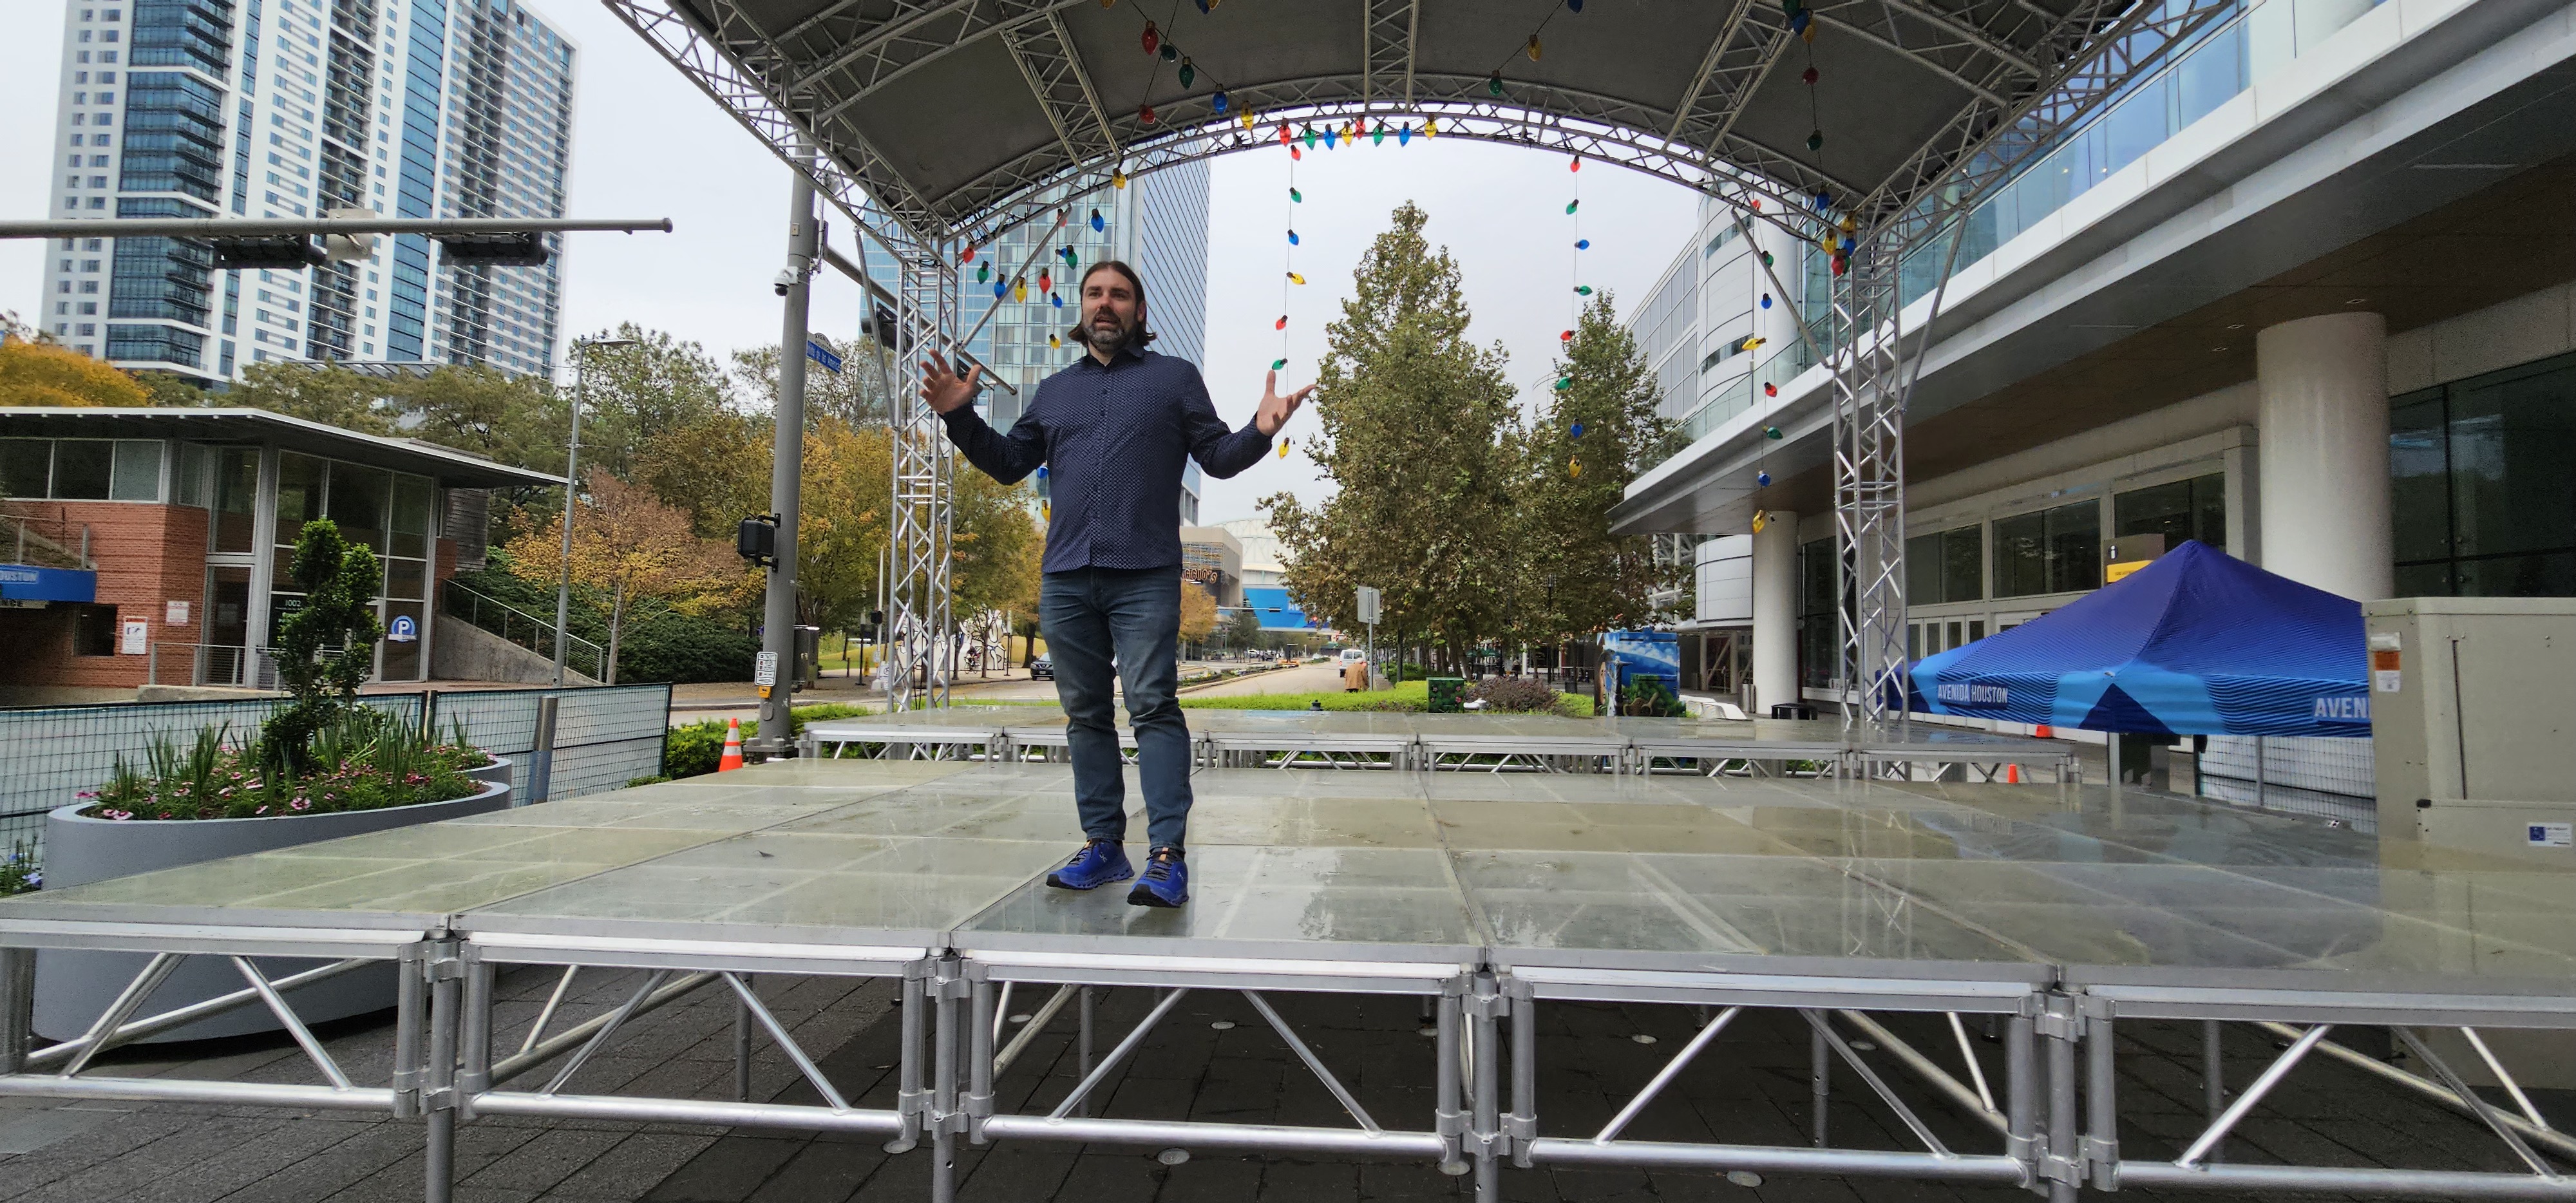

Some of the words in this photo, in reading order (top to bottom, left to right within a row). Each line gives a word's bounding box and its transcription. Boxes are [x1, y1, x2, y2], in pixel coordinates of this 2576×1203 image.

[1182, 568, 1218, 584] IGGIO'S
[399, 620, 410, 635] P
[1938, 684, 1970, 702] AVENIDA
[1971, 685, 2008, 703] HOUSTON
